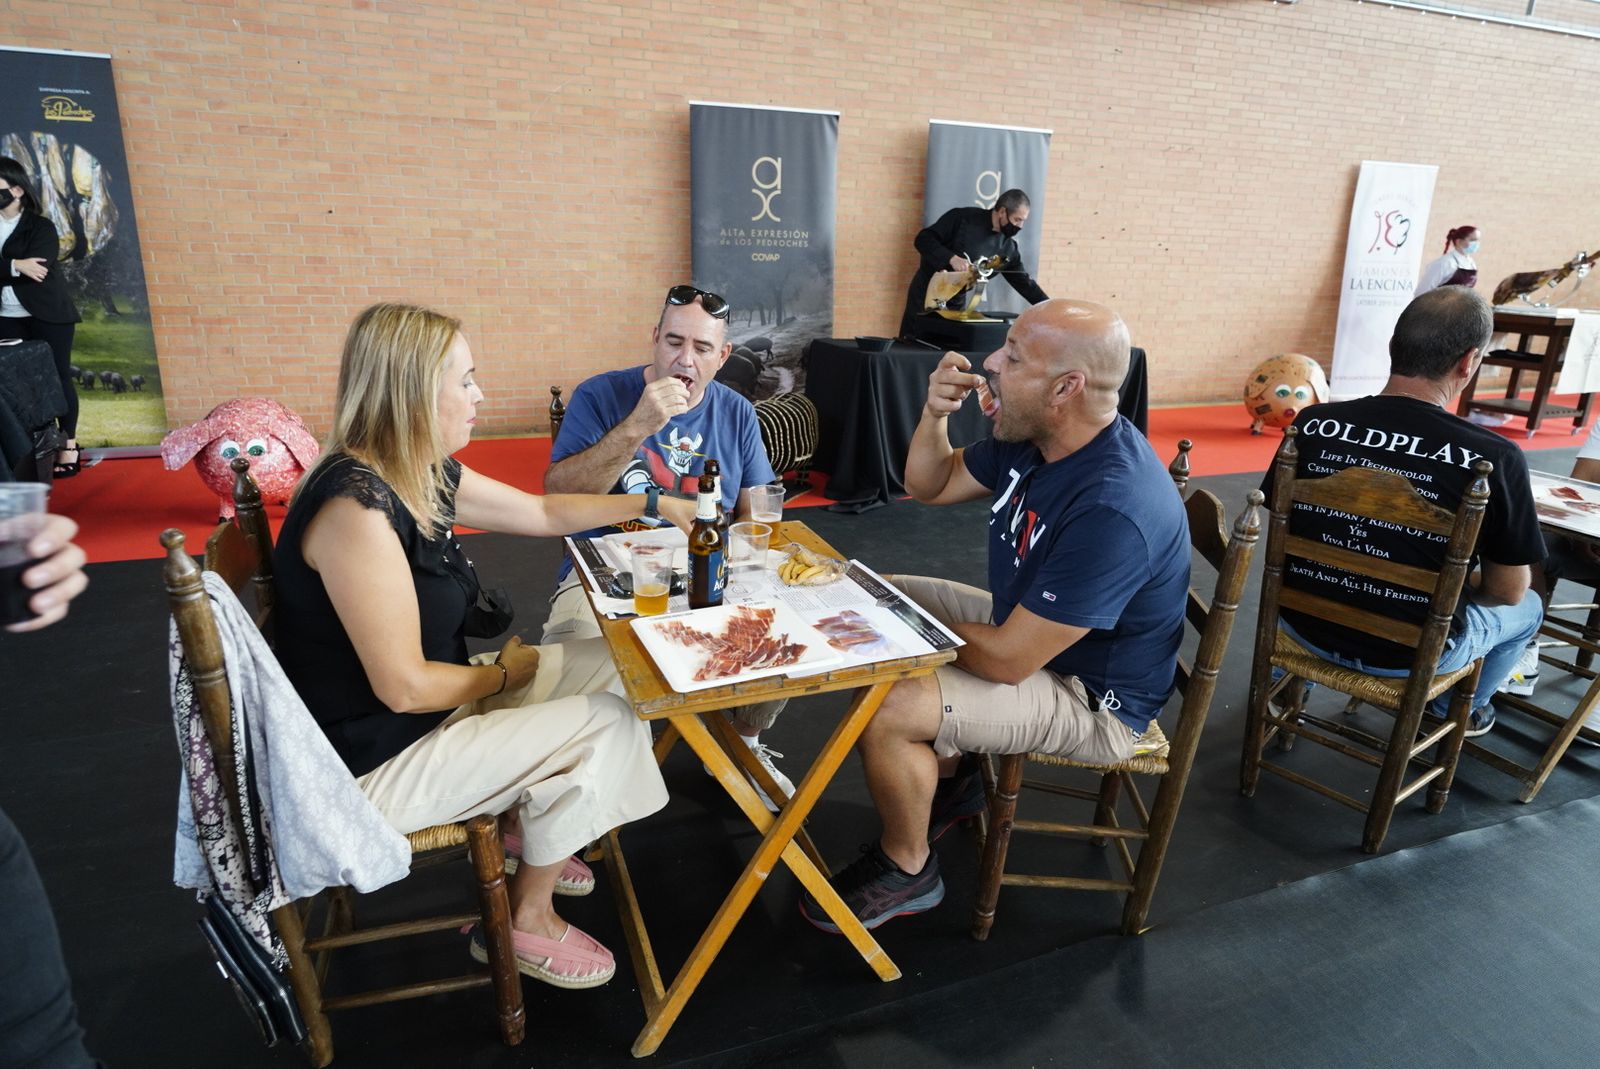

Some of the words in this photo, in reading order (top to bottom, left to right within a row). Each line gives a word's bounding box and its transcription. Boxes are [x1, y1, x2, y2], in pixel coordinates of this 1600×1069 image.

[720, 228, 745, 237] ALTA
[751, 229, 809, 239] EXPRESIÓN
[756, 239, 809, 248] PEDROCHES
[751, 252, 780, 261] COVAP
[1350, 278, 1363, 290] LA
[1367, 279, 1413, 291] ENCINA
[1303, 418, 1484, 470] COLDPLAY
[1415, 487, 1439, 501] DON
[1349, 525, 1368, 538] YES
